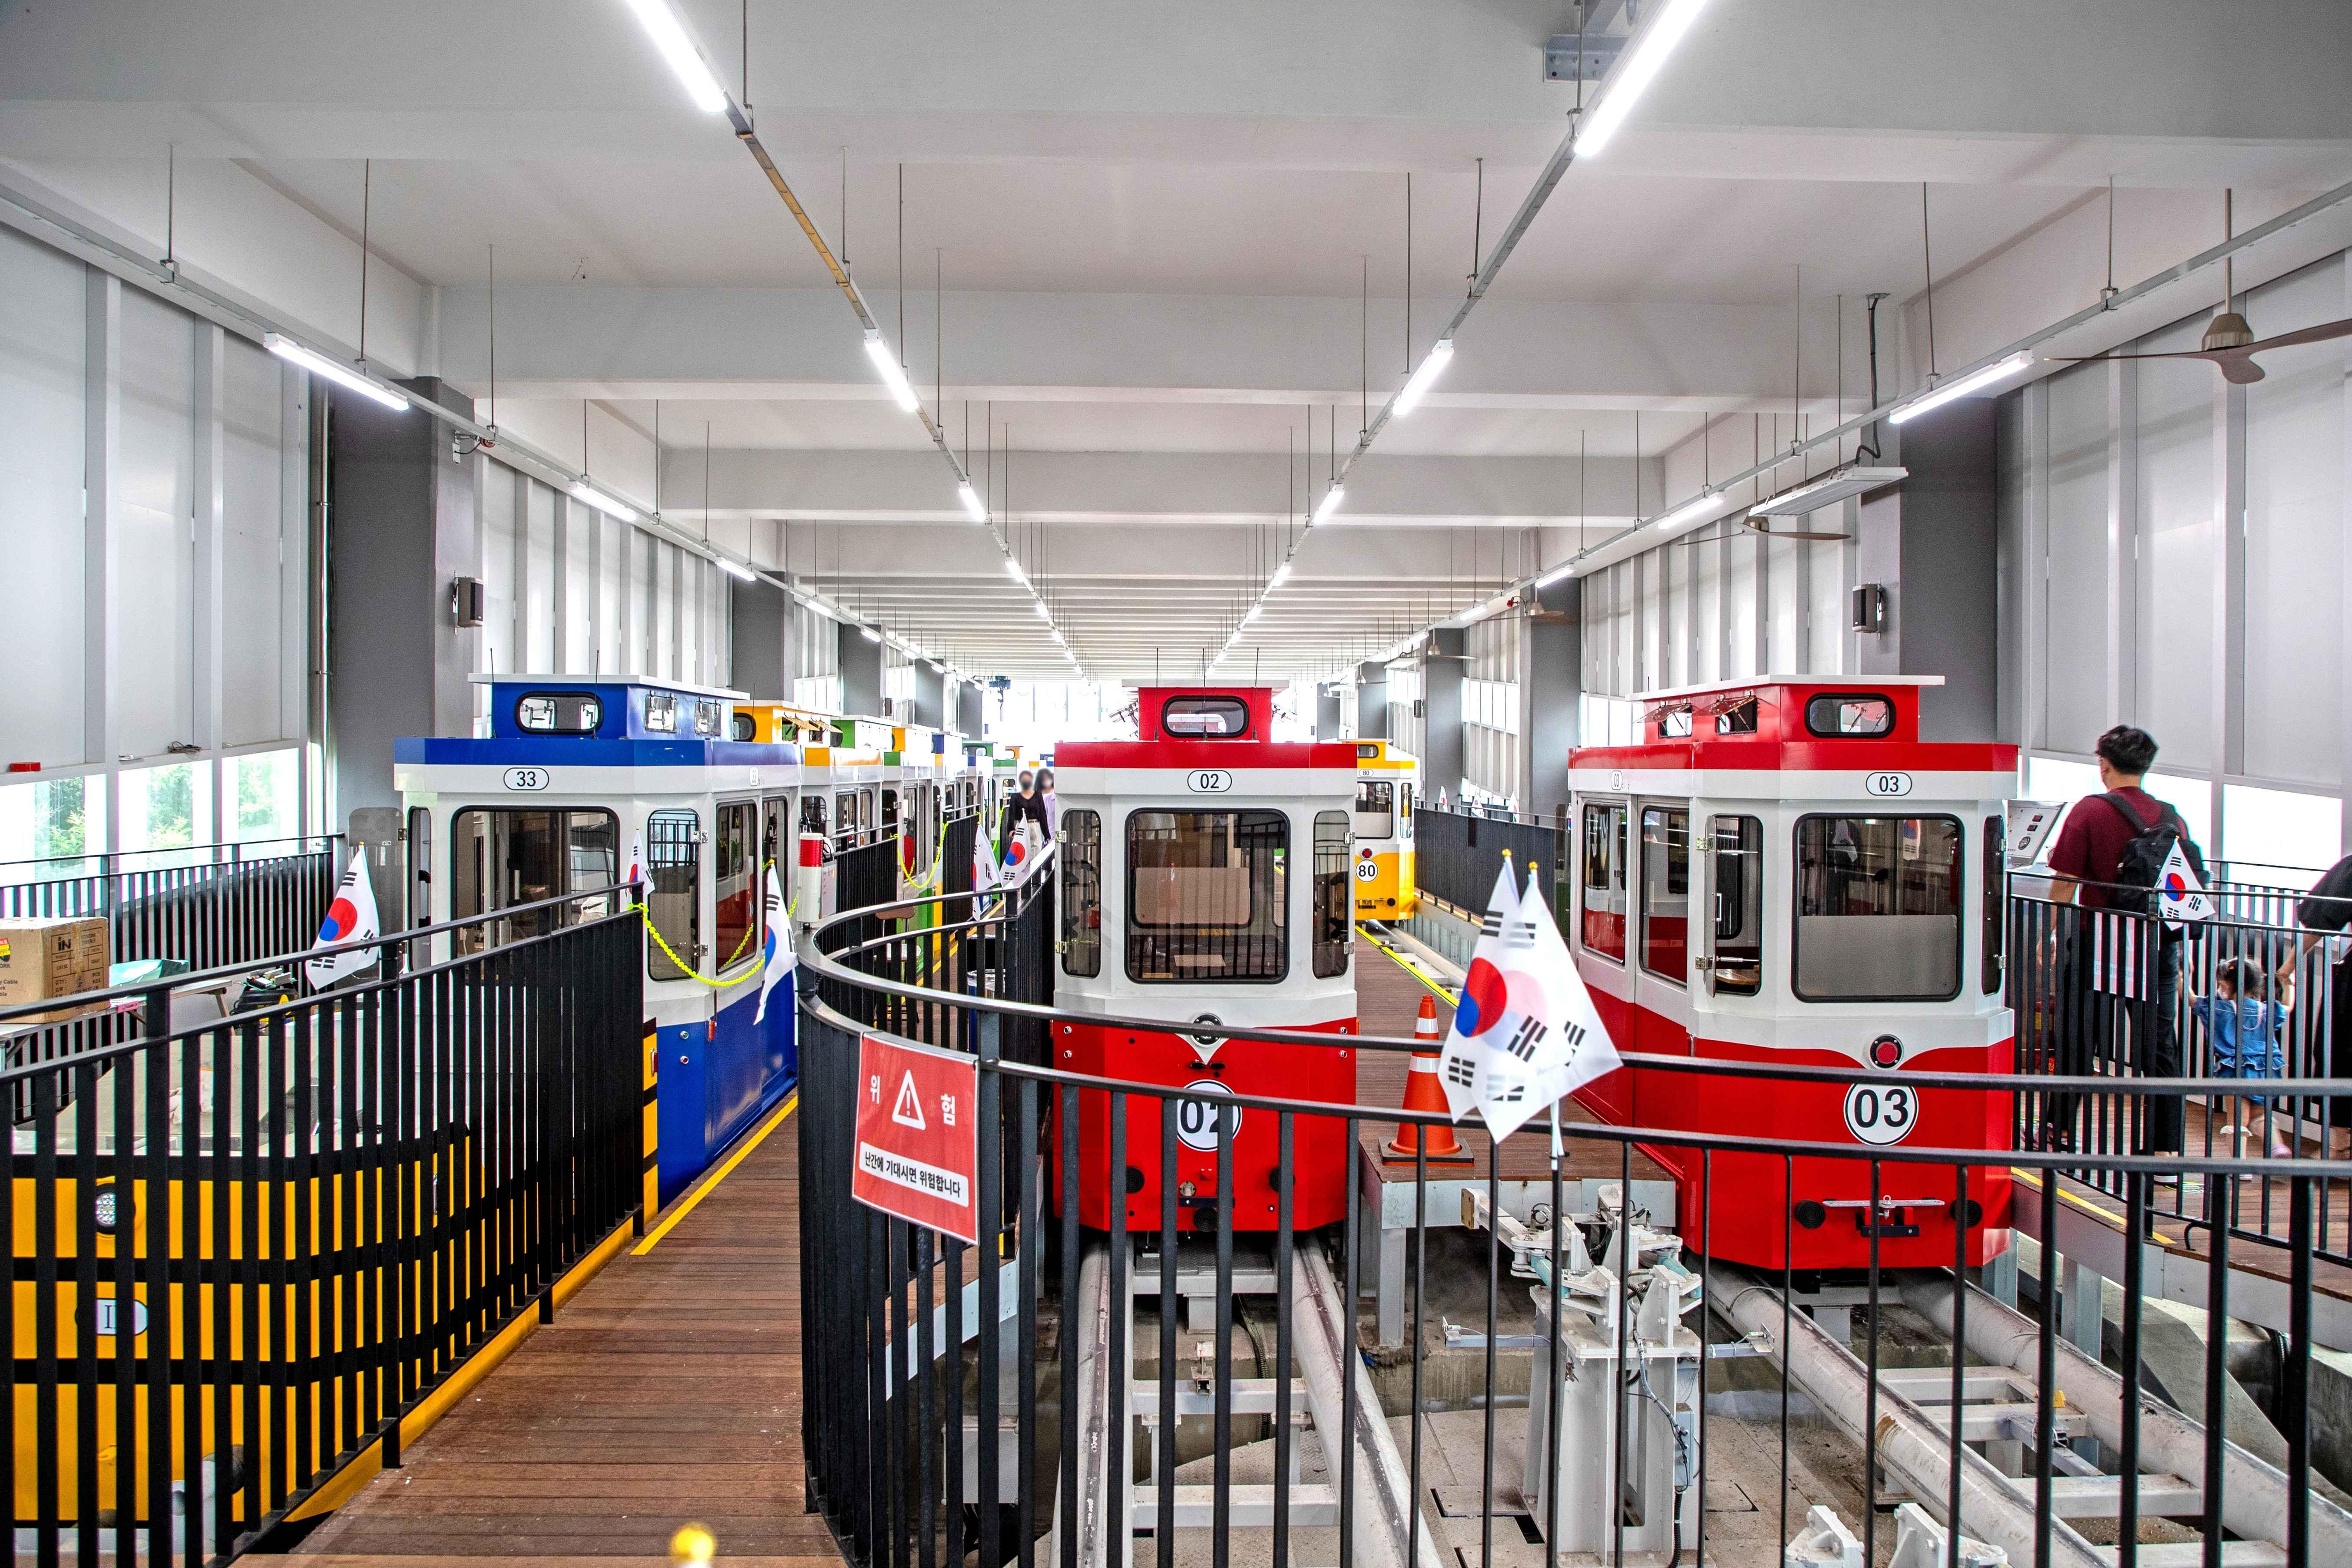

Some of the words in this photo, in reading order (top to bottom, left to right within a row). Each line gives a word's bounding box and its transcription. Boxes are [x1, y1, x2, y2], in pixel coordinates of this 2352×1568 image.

[516, 771, 536, 787] 33
[1200, 774, 1219, 789] 02
[1614, 773, 1619, 787] 03
[1879, 776, 1899, 793] 03
[1358, 865, 1376, 877] 80
[870, 1074, 881, 1105] 위
[940, 1093, 956, 1126] 험
[1854, 1088, 1909, 1128] 03
[865, 1151, 884, 1173] 난간에
[886, 1160, 917, 1183] 기대시면
[919, 1170, 961, 1198] 위험합니다
